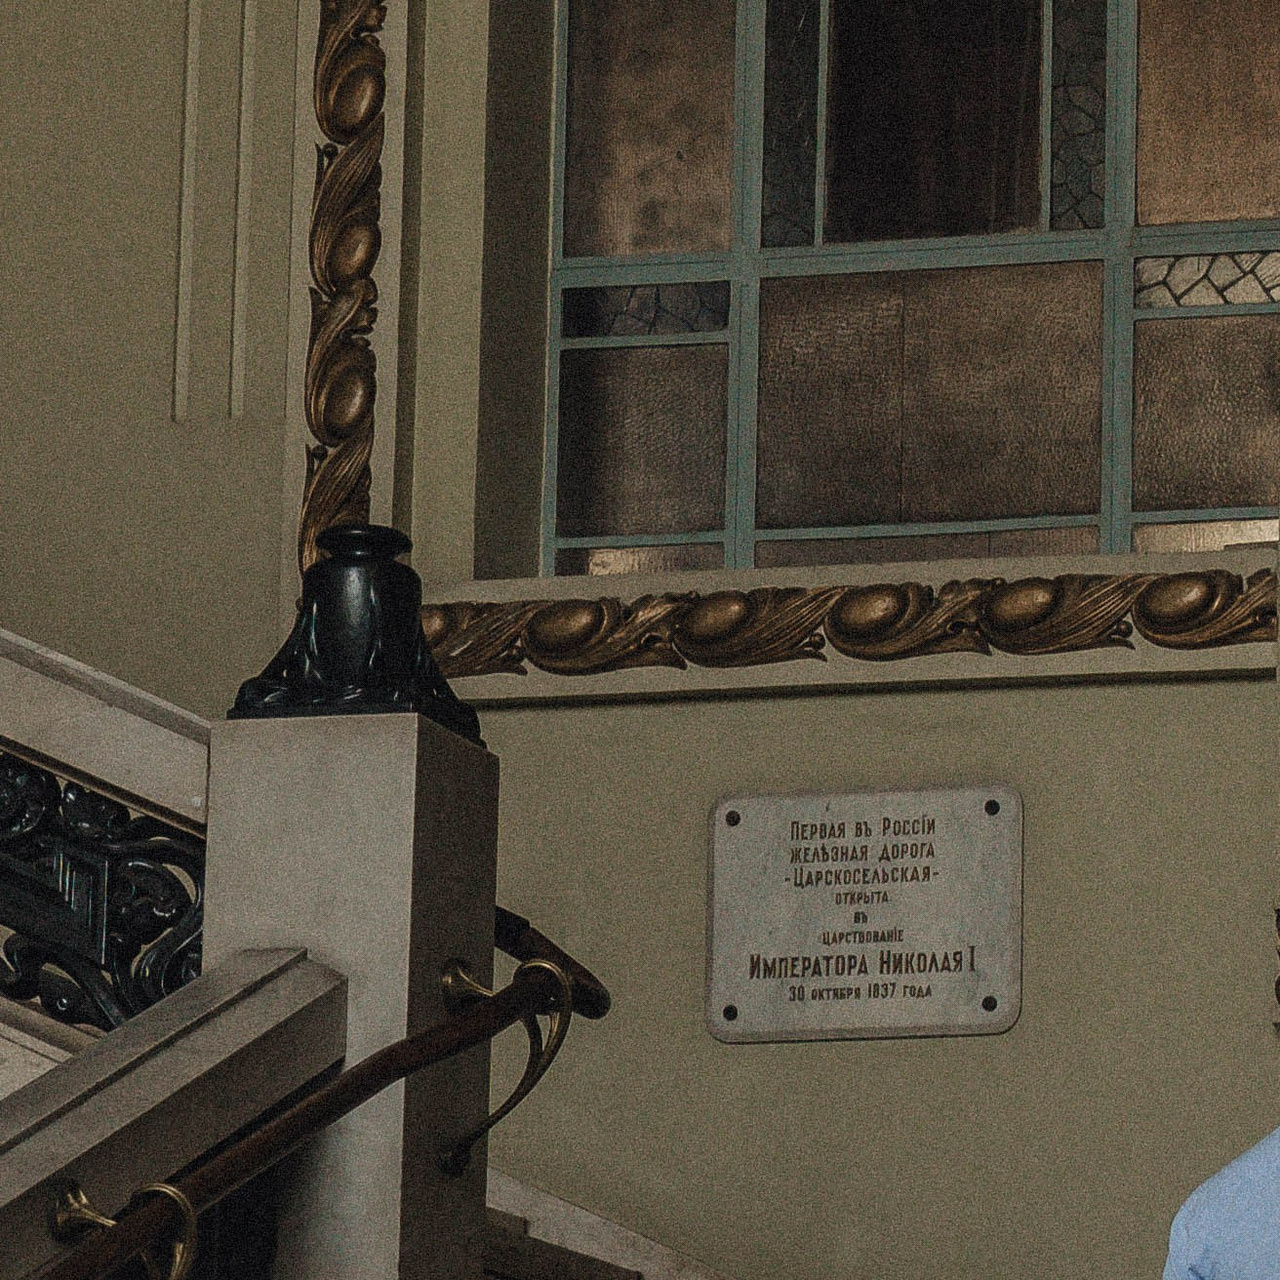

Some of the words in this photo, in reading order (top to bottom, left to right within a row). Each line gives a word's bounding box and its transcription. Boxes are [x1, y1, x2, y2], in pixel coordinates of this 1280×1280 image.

[790, 820, 845, 841] ПЕРВАЯ
[855, 820, 872, 837] ВЪ
[879, 842, 935, 861] ДОРОГА
[835, 891, 889, 904] ОТКРЫТА
[854, 912, 867, 924] ВЪ
[750, 954, 867, 980] ИМПЕРАТОРА
[879, 951, 963, 975] НИКОЛАЯ
[790, 985, 805, 1001] 30
[812, 987, 861, 1001] ОКТЯБРЯ
[868, 983, 896, 999] 1837
[903, 984, 932, 998] ГОДА
